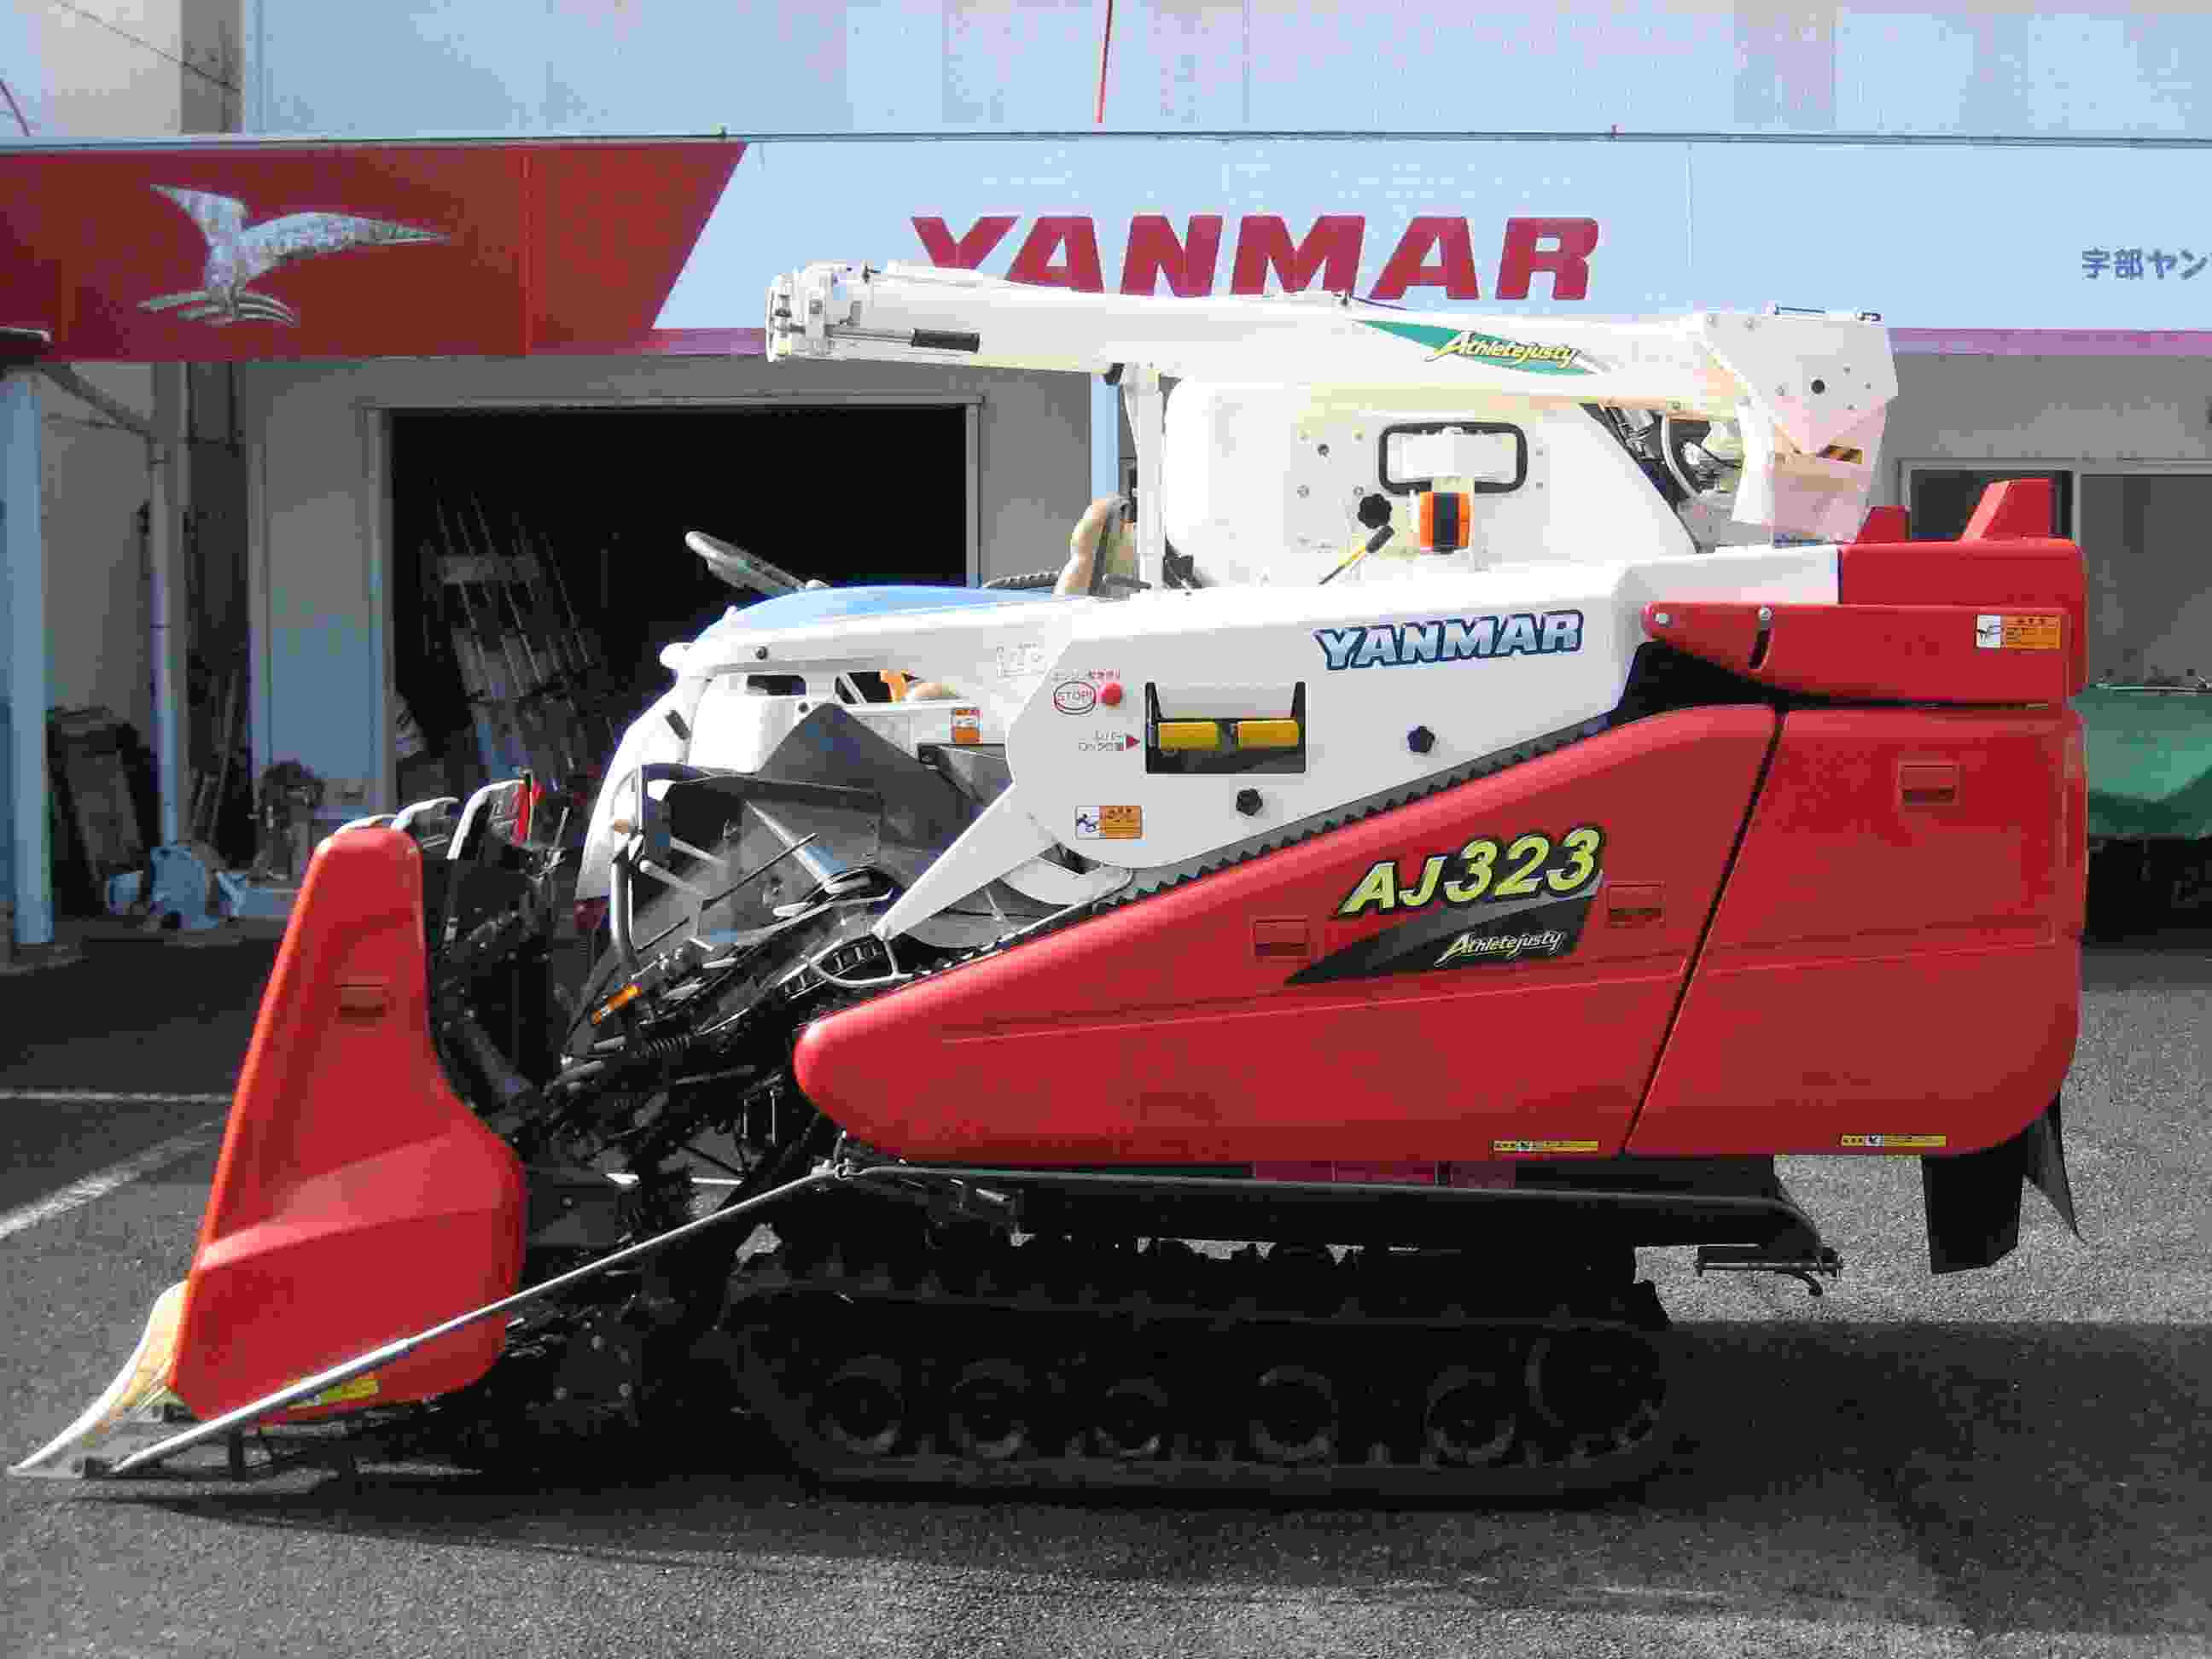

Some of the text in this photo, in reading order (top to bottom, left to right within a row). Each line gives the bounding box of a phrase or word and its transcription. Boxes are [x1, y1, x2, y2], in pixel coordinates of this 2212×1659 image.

[911, 215, 1599, 300] YANMAR
[2081, 247, 2212, 280] 宇部ヤン
[1426, 329, 1575, 369] Athletejusty
[1313, 609, 1584, 670] YANMAR
[1335, 827, 1602, 915] AJ323
[1434, 931, 1568, 969] Athletejusty
